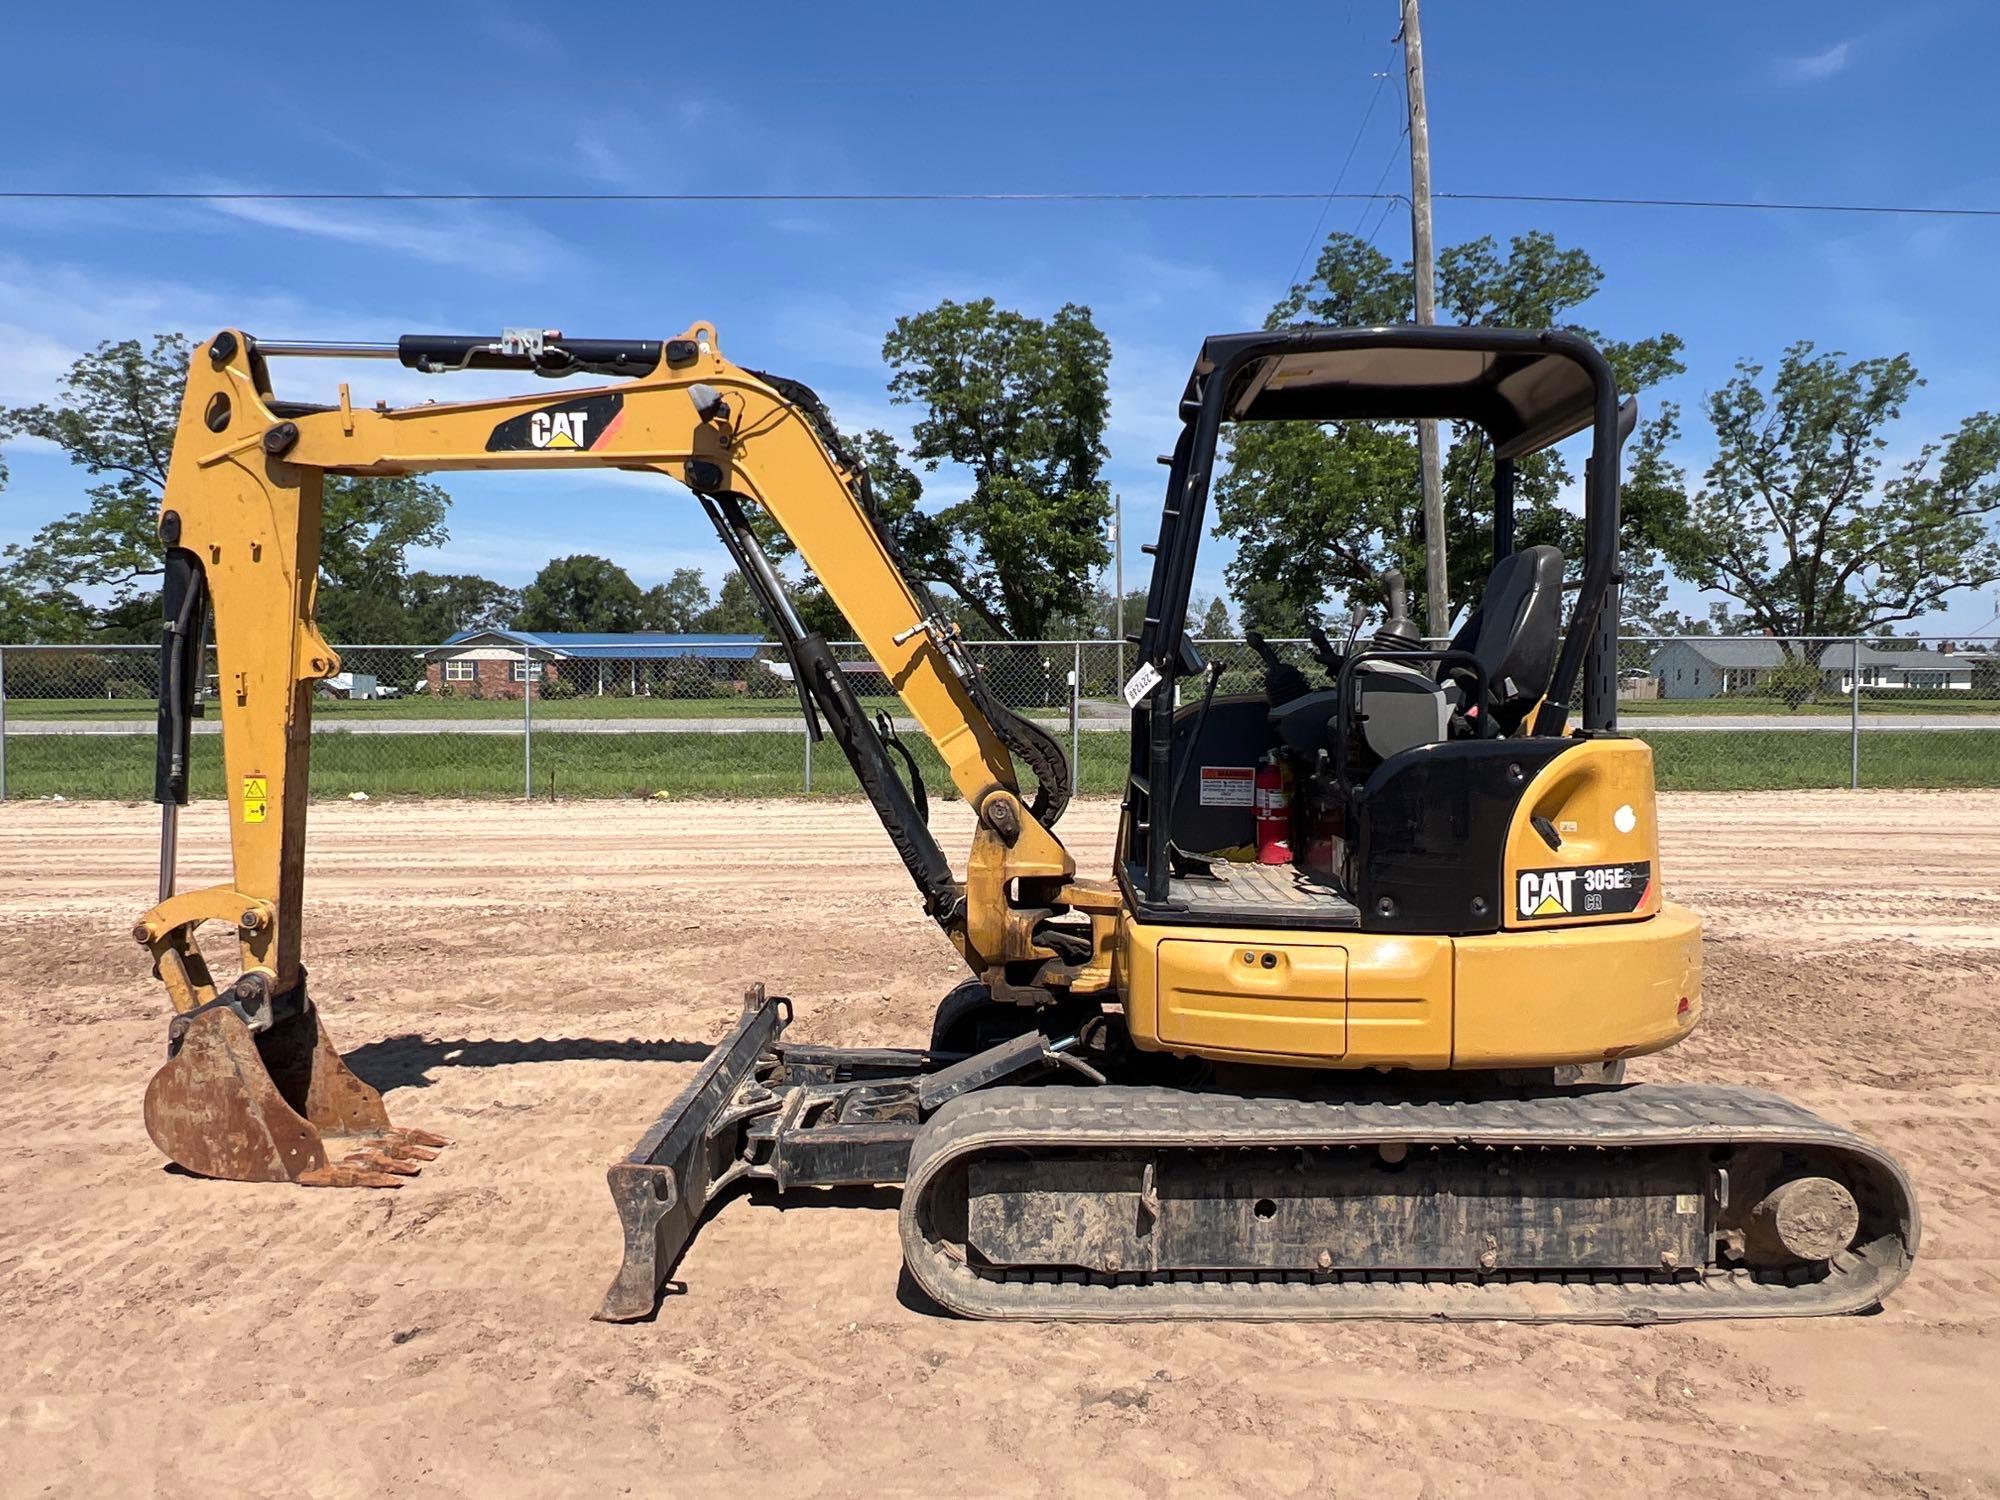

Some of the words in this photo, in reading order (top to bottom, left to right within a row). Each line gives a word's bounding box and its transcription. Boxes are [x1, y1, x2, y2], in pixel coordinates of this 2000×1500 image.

[531, 412, 588, 448] CAT
[1519, 871, 1576, 916] CAT
[1584, 894, 1603, 911] CR
